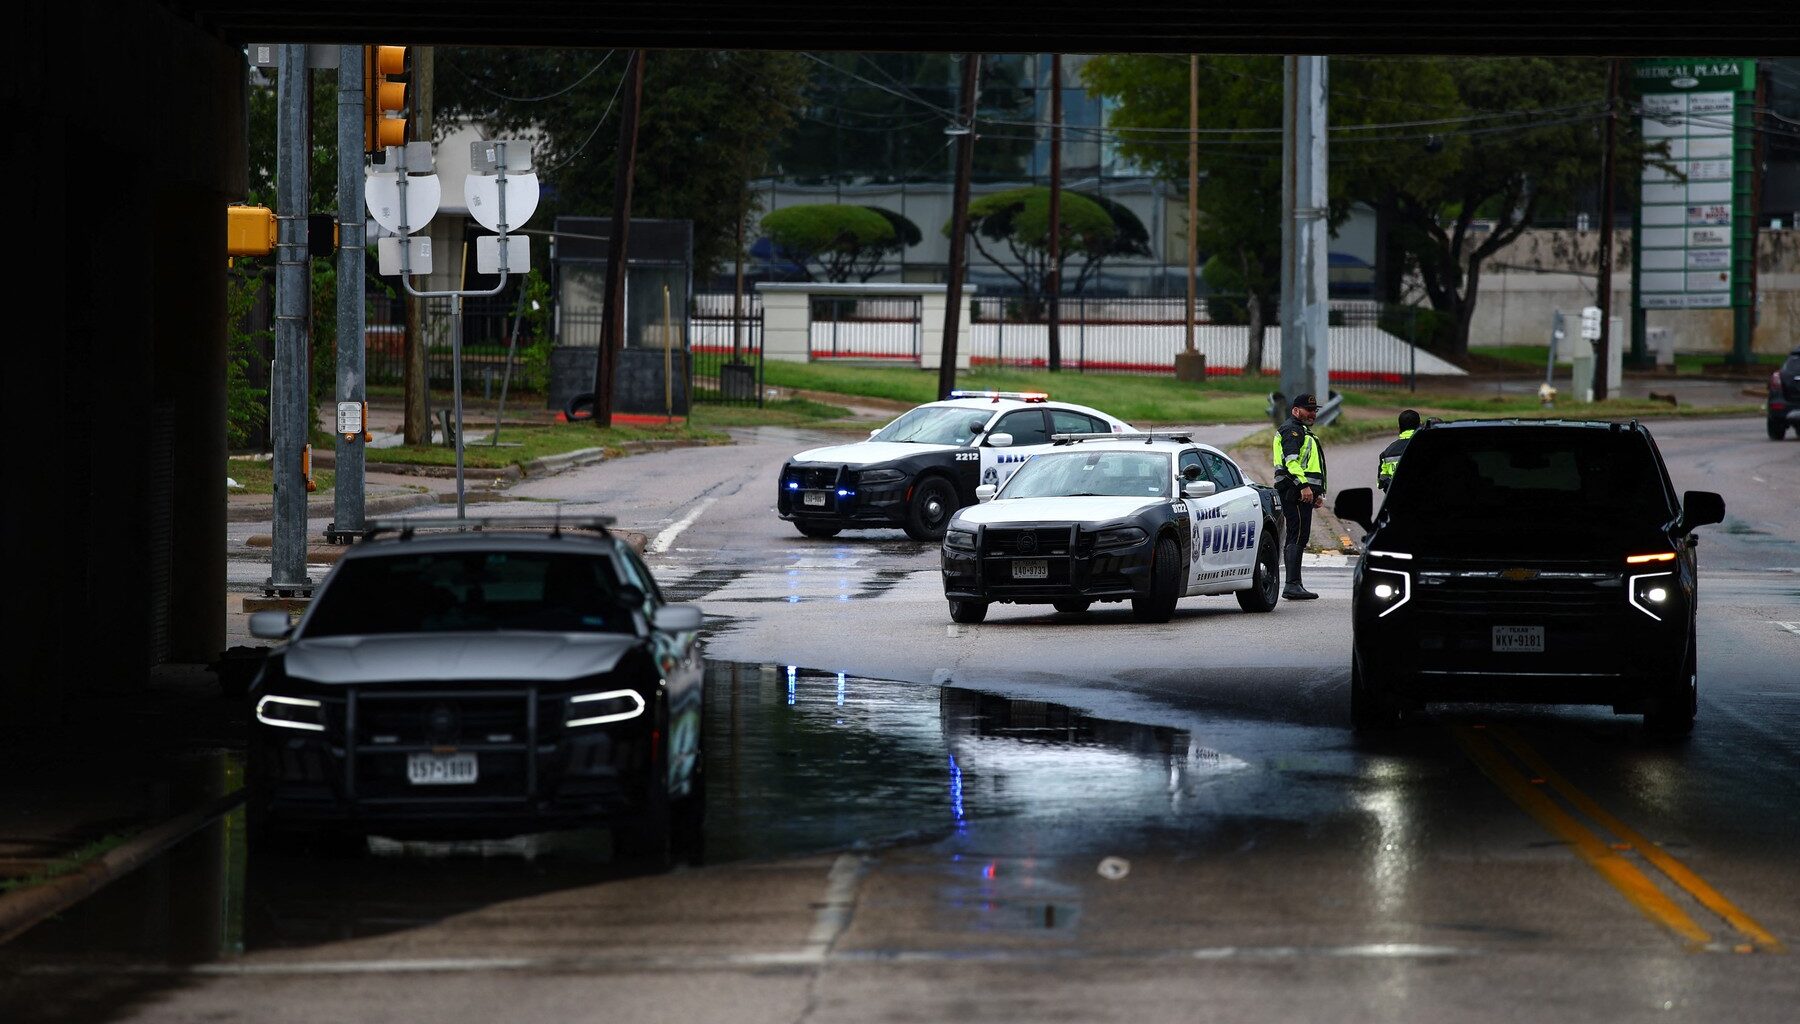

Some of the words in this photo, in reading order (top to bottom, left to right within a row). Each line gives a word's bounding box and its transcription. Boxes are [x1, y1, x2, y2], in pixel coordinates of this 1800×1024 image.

[1694, 62, 1740, 77] PLAZA
[955, 452, 979, 461] 2212
[1196, 506, 1221, 521] DALLAS
[1201, 520, 1256, 556] POLICE
[1197, 571, 1220, 581] SERVING
[1220, 568, 1236, 578] SINCE
